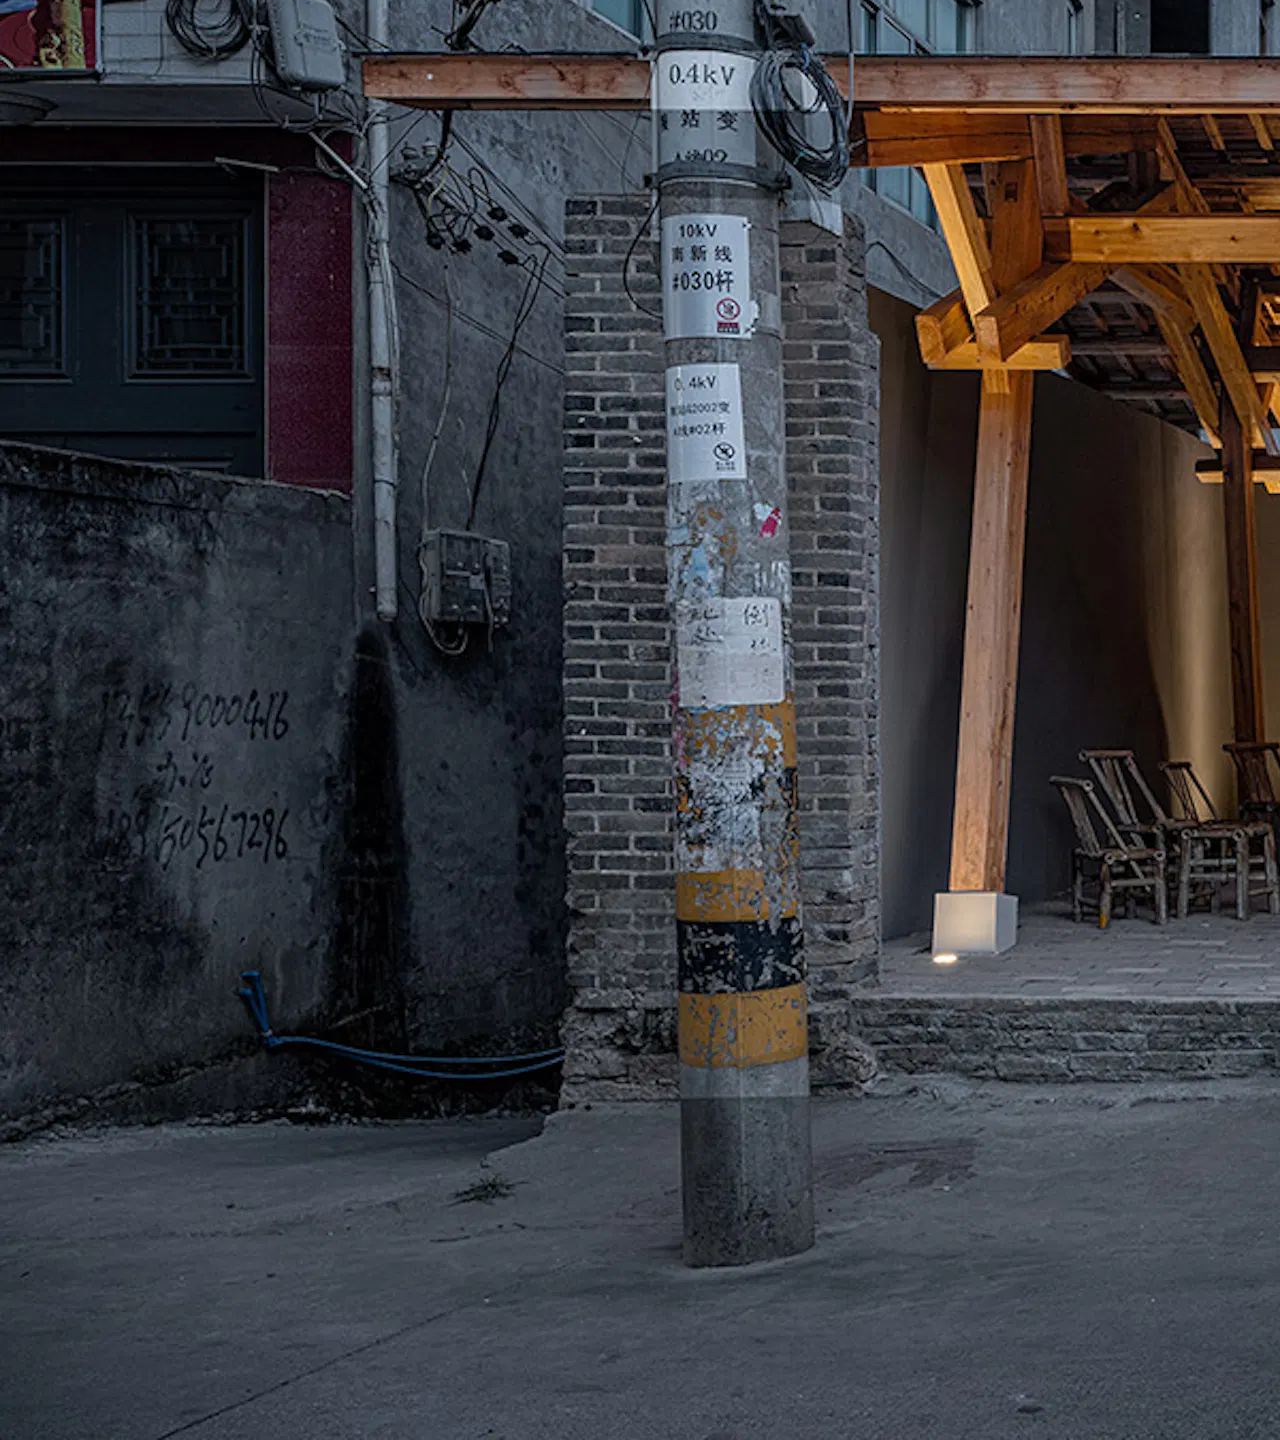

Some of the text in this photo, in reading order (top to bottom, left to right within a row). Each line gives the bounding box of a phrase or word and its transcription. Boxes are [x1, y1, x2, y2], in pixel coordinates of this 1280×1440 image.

[669, 10, 718, 31] #030
[679, 223, 717, 238] 10kV
[672, 270, 735, 293] #030杆
